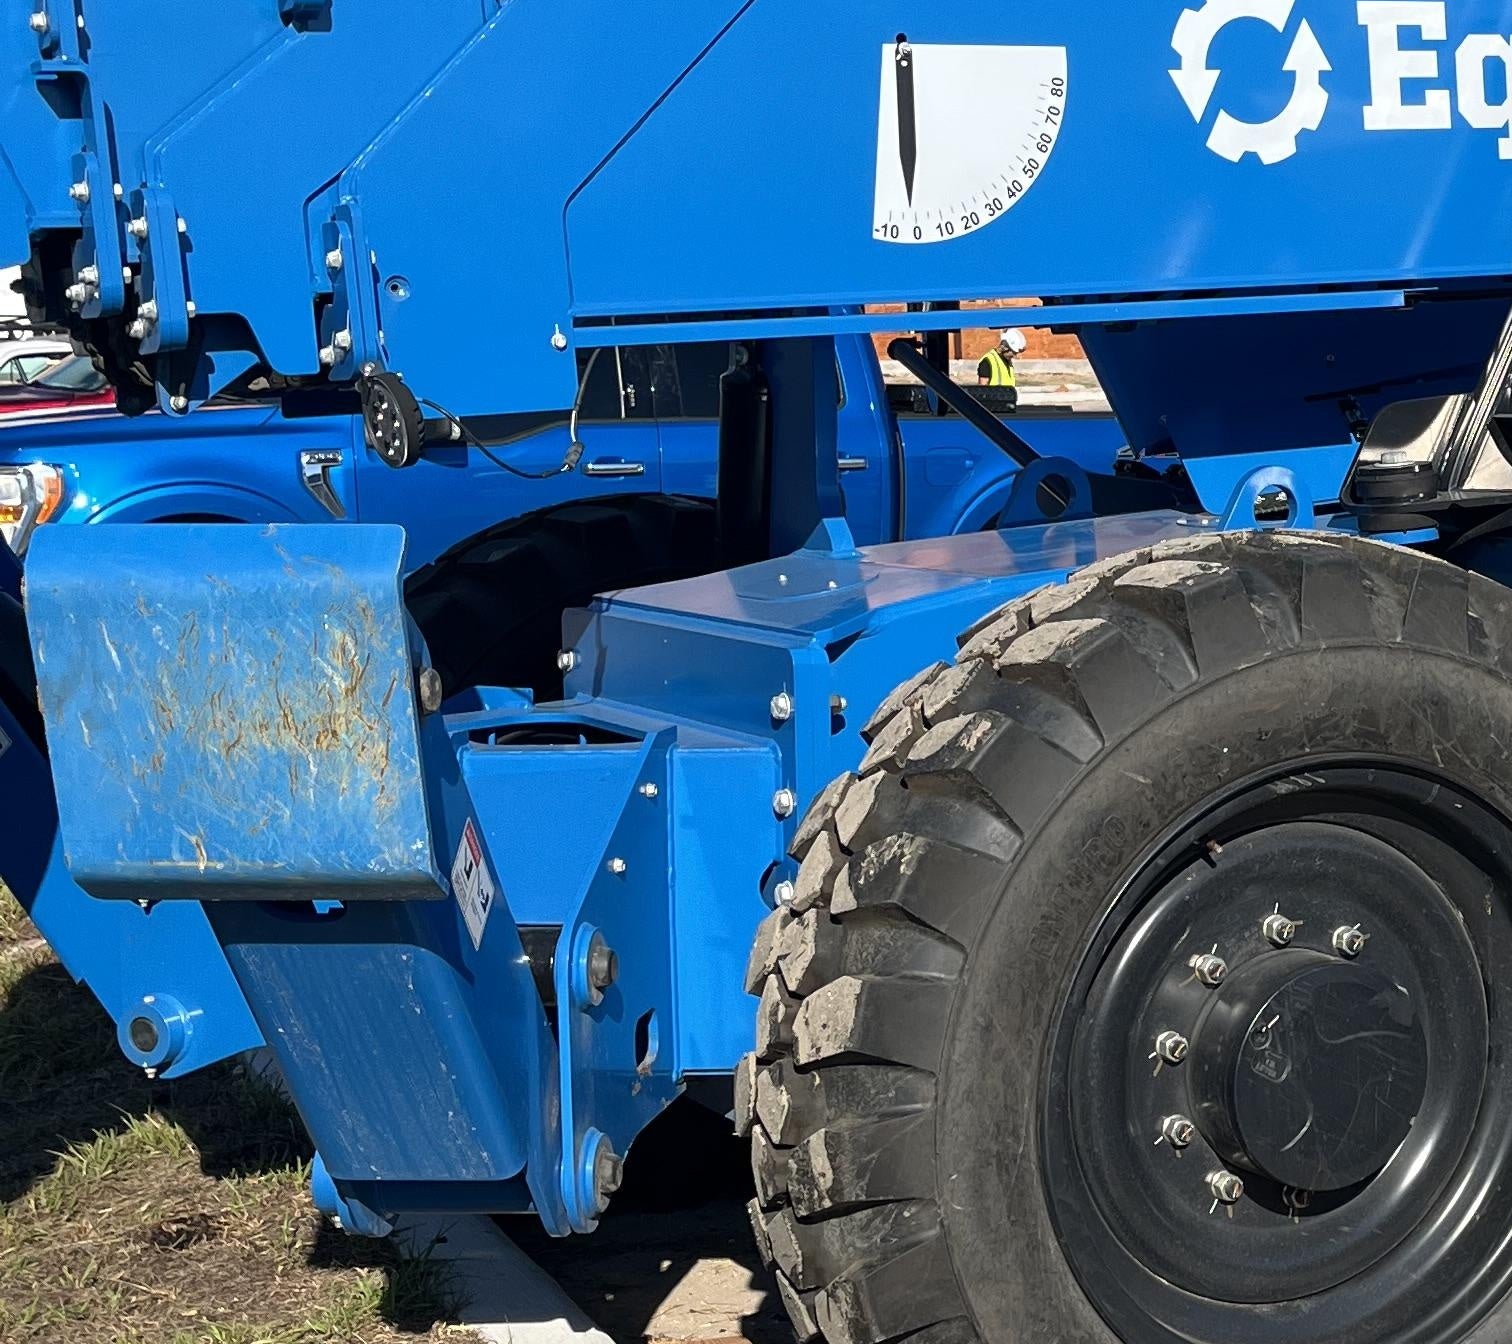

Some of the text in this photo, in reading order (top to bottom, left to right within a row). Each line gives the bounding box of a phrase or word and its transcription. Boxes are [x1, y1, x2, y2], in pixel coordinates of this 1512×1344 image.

[874, 77, 1064, 240] -10 0 10 20 30 40 50 60 70 80
